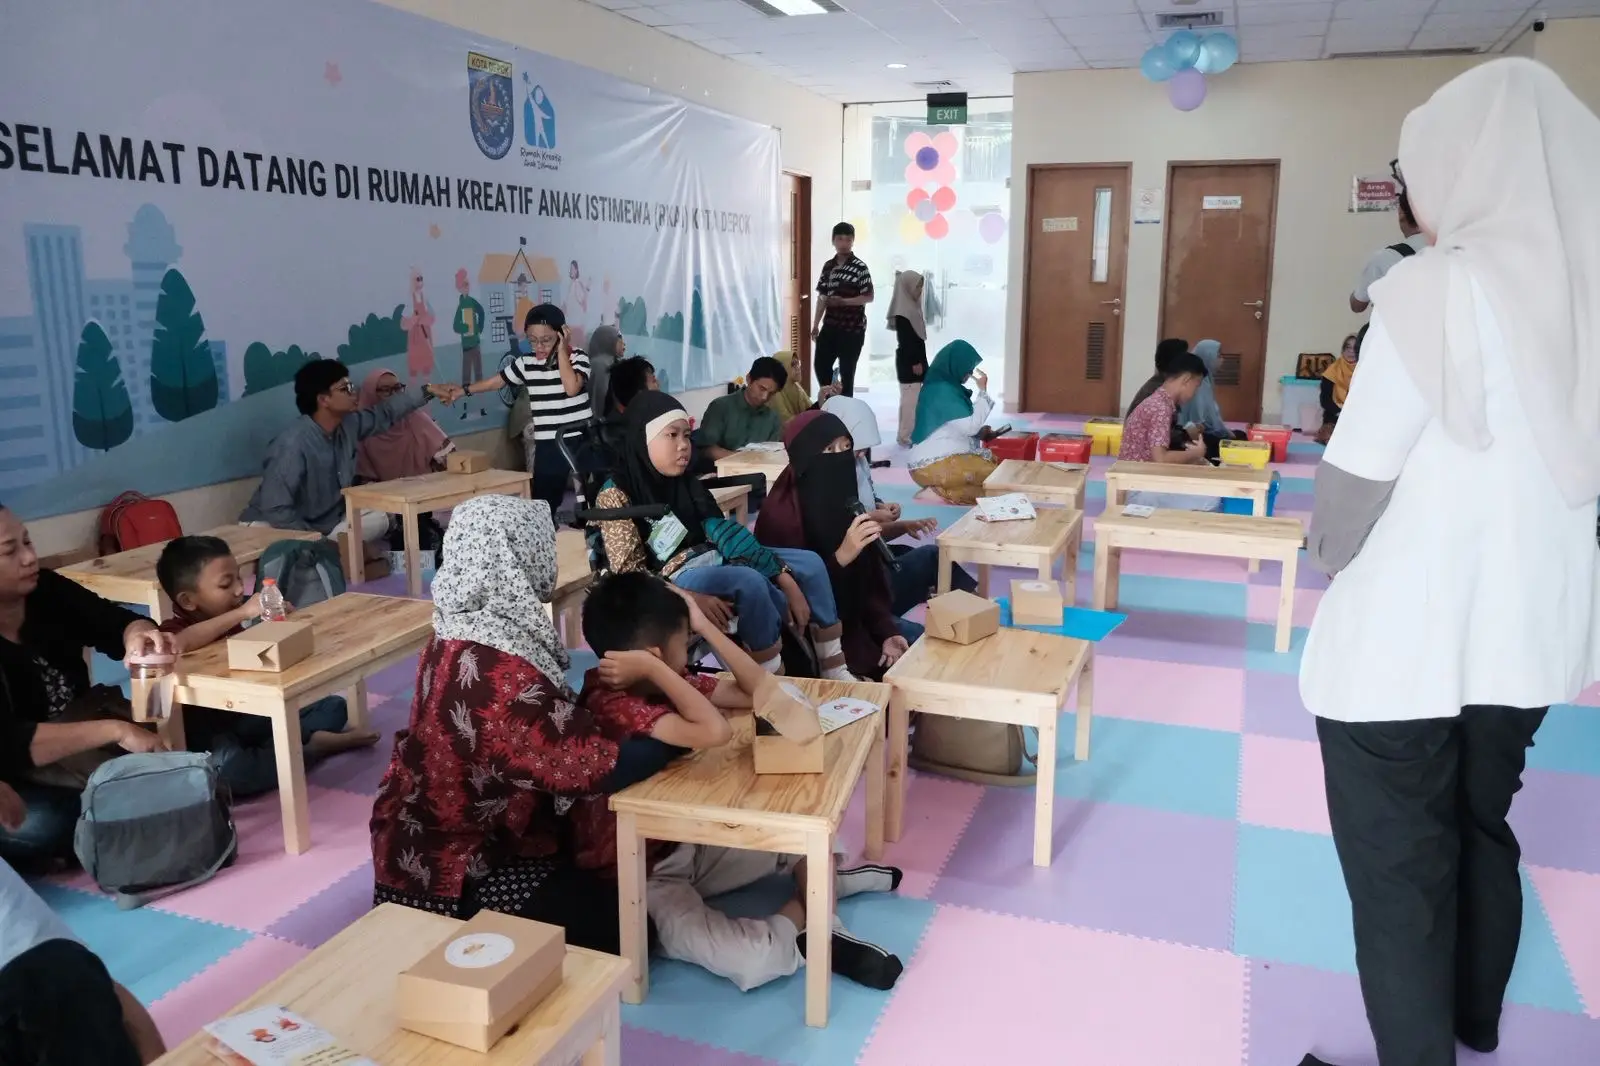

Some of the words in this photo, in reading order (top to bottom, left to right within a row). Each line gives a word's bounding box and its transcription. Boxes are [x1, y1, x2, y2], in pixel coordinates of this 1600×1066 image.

[936, 108, 959, 120] EXIT
[520, 147, 541, 158] Rumah
[0, 121, 186, 184] SELAMAT
[197, 146, 327, 197] DATANG
[334, 163, 360, 200] DI
[367, 167, 451, 208] RUMAH
[457, 178, 533, 215] KREATIF
[538, 188, 582, 219] ANAK
[585, 194, 651, 225] ISTIMEWA
